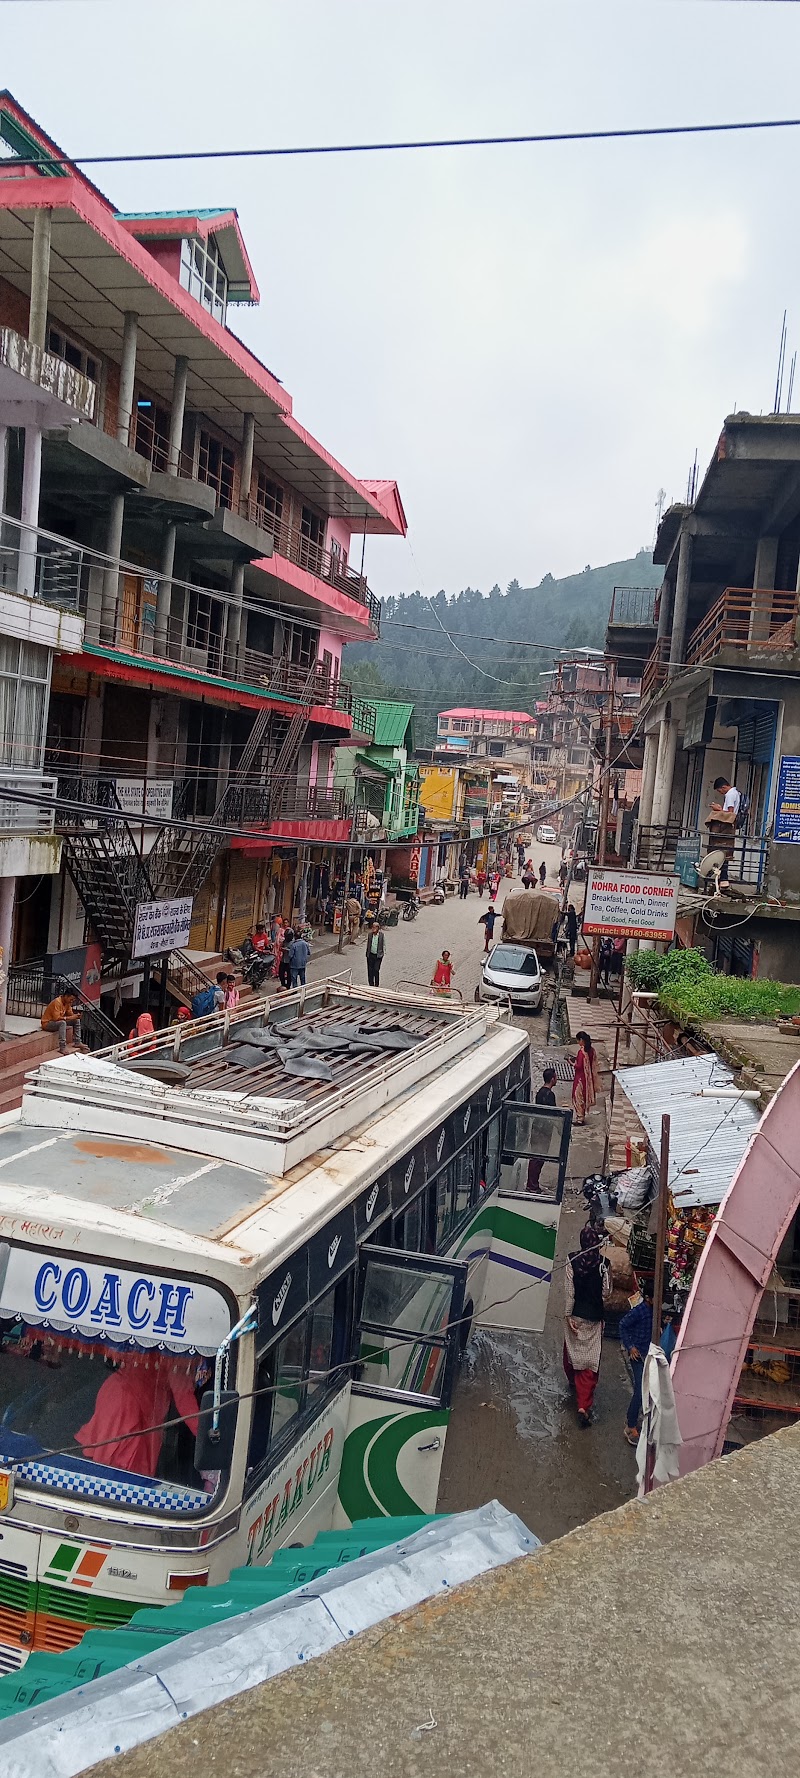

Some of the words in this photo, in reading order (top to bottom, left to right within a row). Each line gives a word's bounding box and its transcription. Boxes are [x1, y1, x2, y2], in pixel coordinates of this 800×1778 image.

[592, 882, 618, 892] NOHRA
[620, 884, 640, 894] FOOD
[643, 886, 674, 897] CORNER
[592, 894, 623, 904] Breakfast,
[626, 897, 646, 906] Lunch,
[648, 899, 669, 908] Dinner
[590, 904, 604, 913] Tea,
[606, 905, 628, 915] Coffee,
[631, 908, 646, 916] Cold
[647, 909, 668, 918] Drinks
[611, 916, 627, 924] Good,
[588, 926, 619, 934] Contact:
[620, 929, 667, 939] 98160-63955
[20, 1220, 64, 1240] महाराज
[34, 1261, 194, 1338] COACH
[246, 1427, 334, 1567] THAKUR
